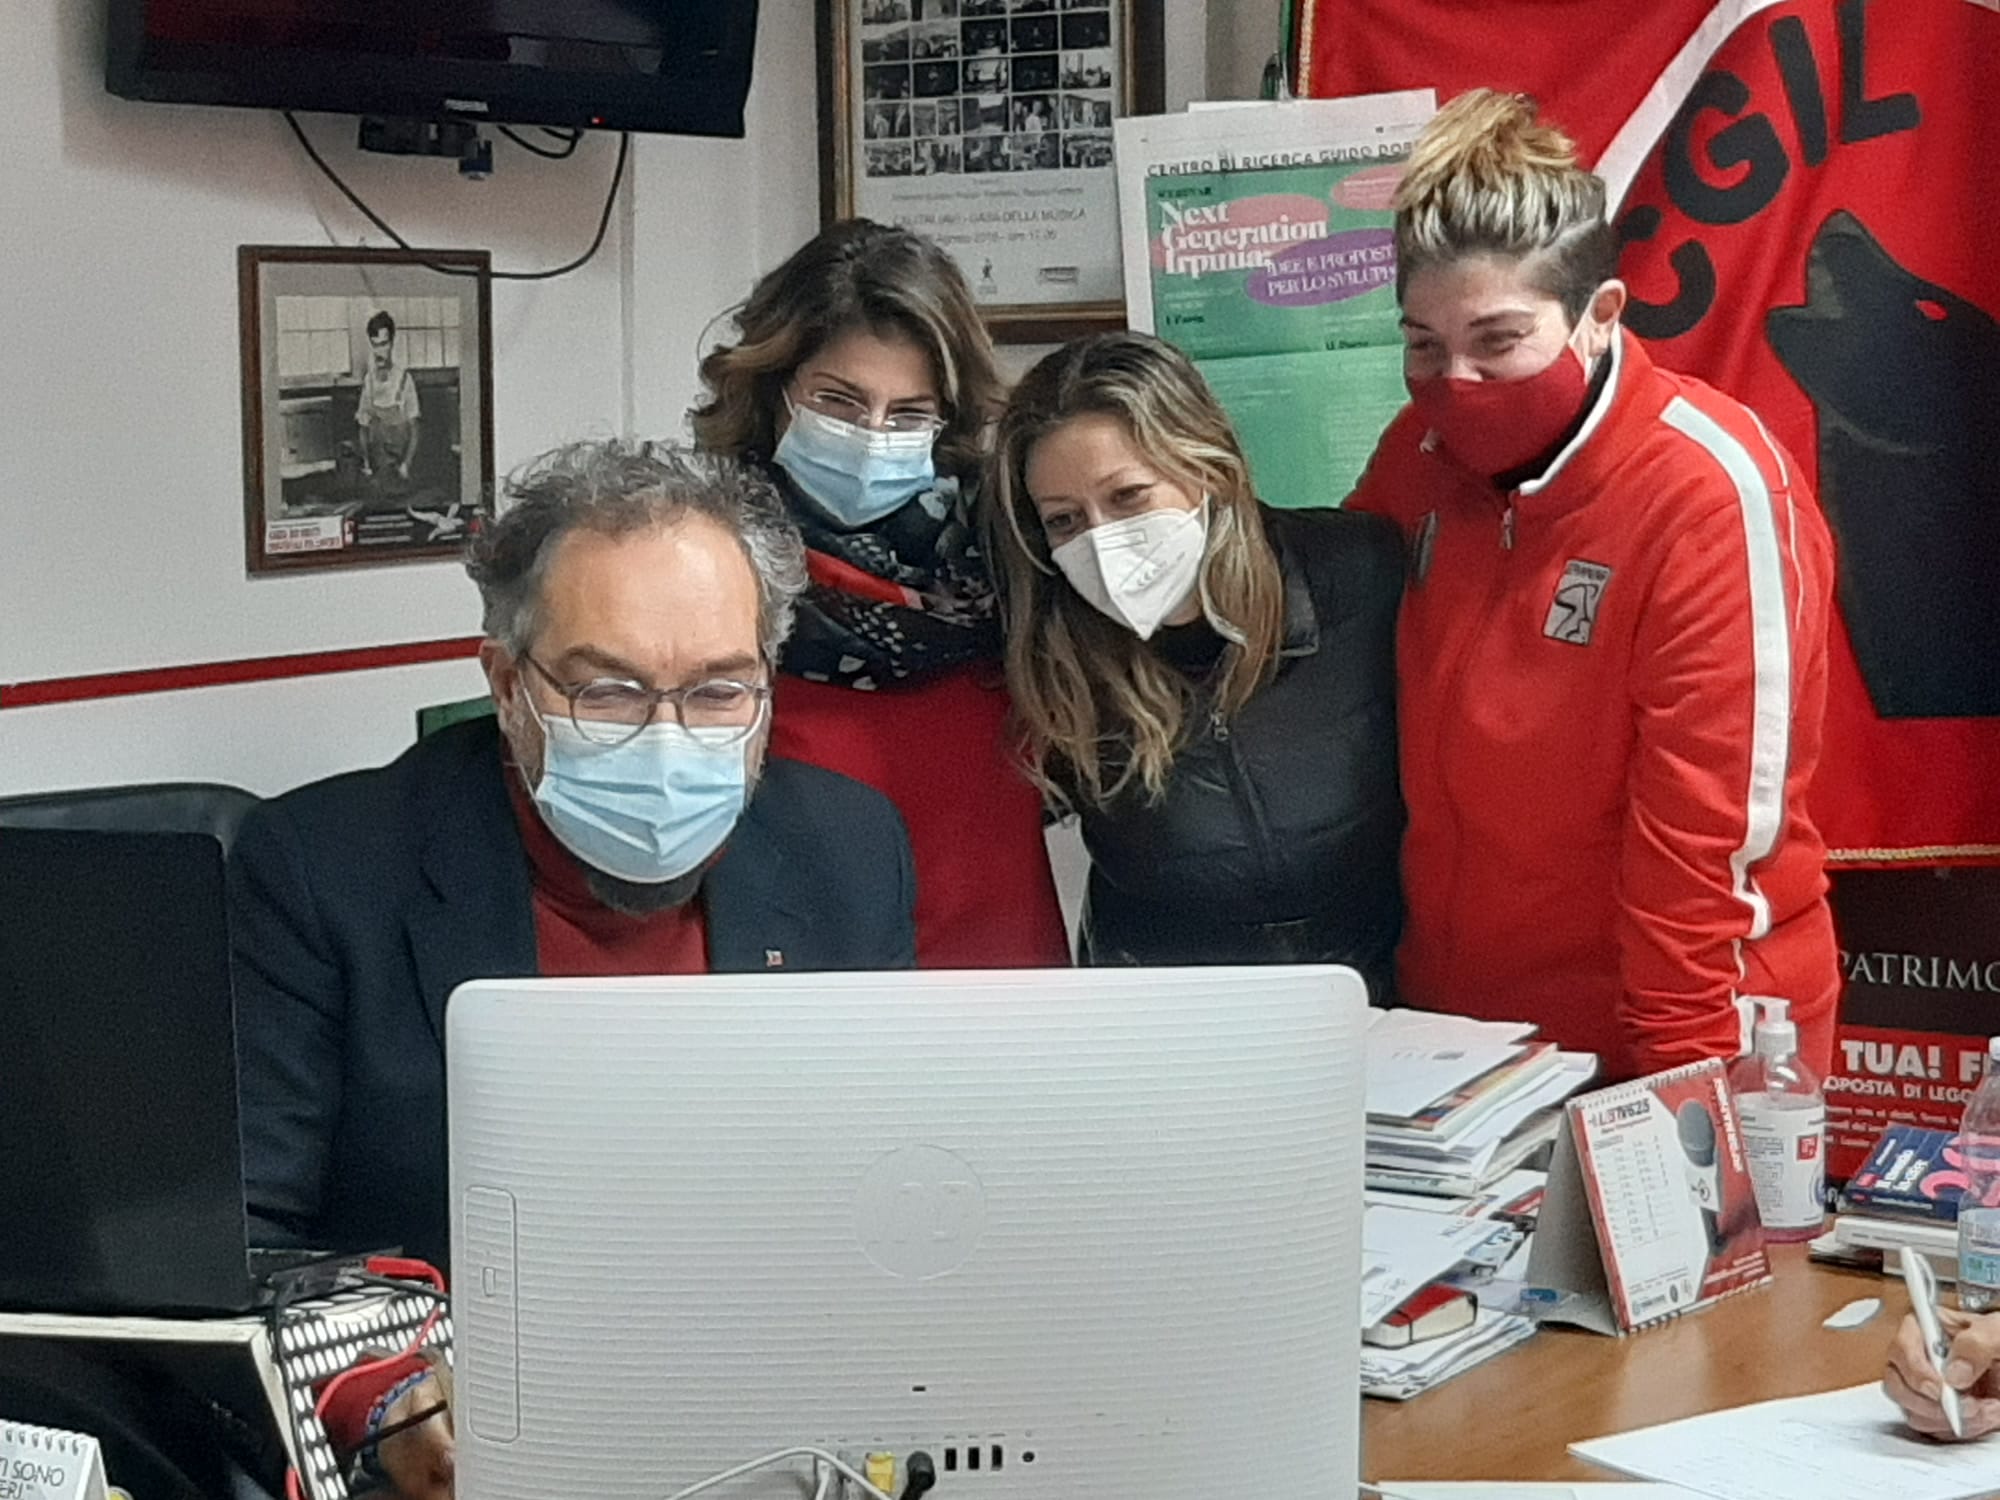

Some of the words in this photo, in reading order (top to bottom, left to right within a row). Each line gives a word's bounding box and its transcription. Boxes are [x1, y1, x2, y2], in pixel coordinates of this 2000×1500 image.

[1147, 160, 1213, 177] CENTRO
[1219, 157, 1236, 171] DI
[1242, 152, 1313, 169] RICERCA
[1319, 146, 1373, 162] GUIDO
[1160, 199, 1230, 233] Next
[1162, 213, 1329, 251] Generation
[1268, 279, 1300, 297] PER
[1301, 275, 1326, 293] LO
[1840, 1039, 1941, 1080] TUA!
[1903, 1083, 1922, 1099] DI
[12, 1459, 65, 1487] SONO
